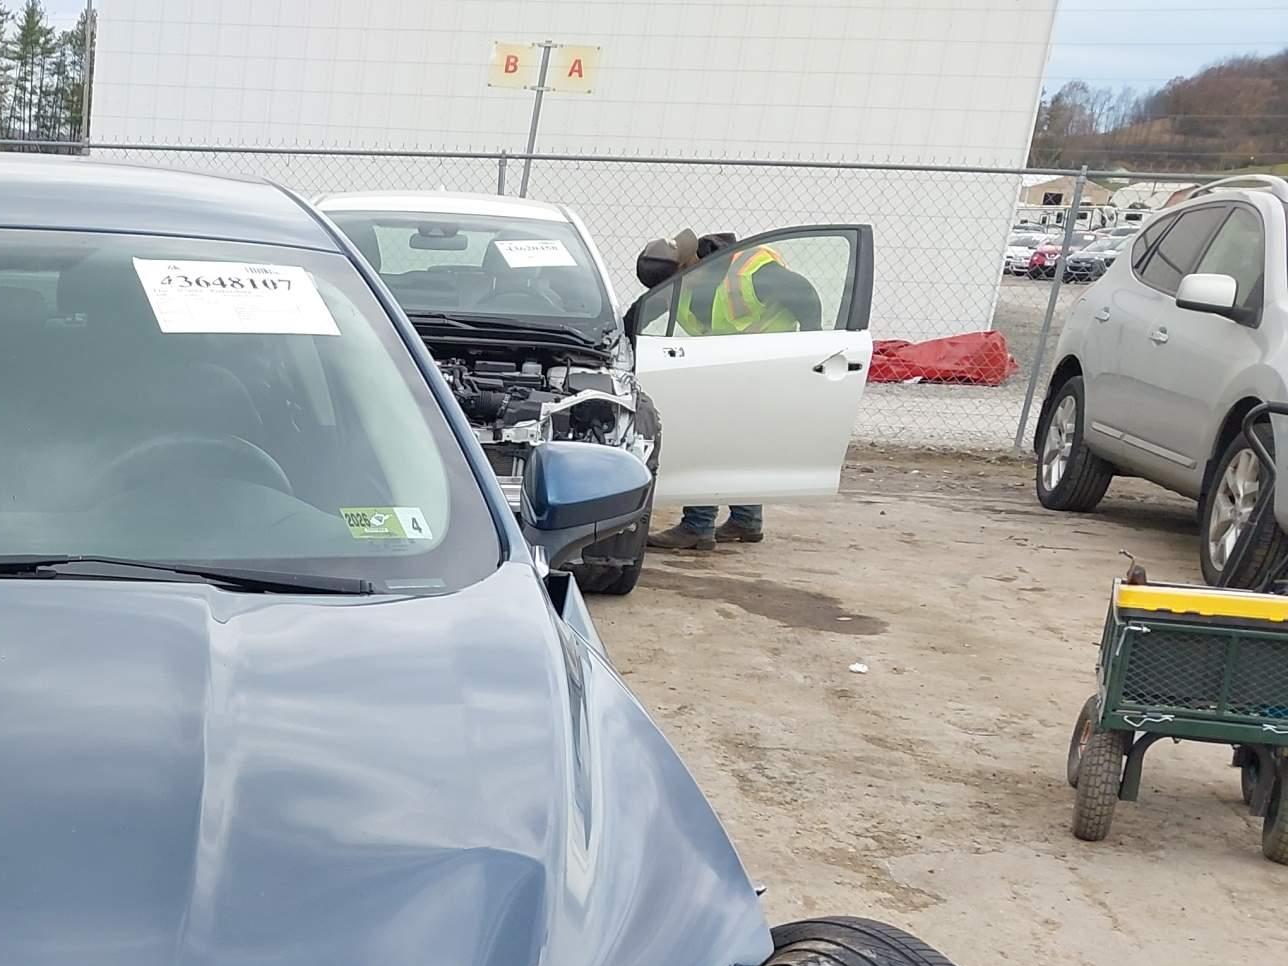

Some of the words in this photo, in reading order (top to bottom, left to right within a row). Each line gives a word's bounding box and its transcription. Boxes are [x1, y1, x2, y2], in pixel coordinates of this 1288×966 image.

[504, 55, 519, 74] B
[568, 59, 583, 78] A
[160, 274, 292, 291] 43648107
[345, 513, 371, 527] 2026
[412, 517, 422, 533] 4
